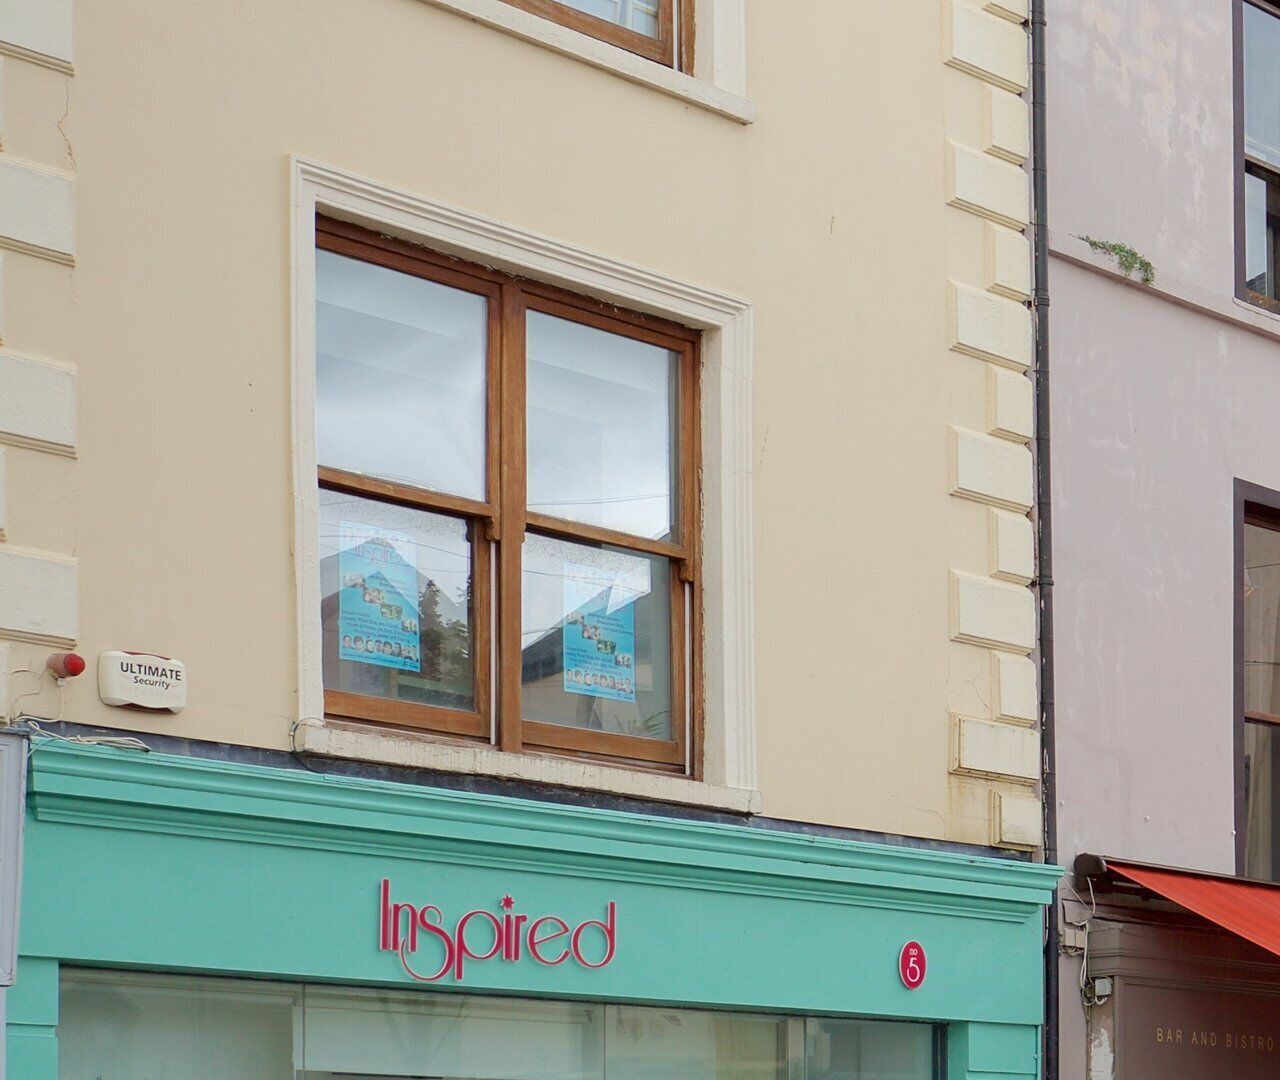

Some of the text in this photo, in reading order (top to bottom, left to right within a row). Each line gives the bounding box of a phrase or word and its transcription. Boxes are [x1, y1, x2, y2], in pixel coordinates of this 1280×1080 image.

[121, 662, 182, 681] ULTIMATE
[134, 676, 170, 690] Security
[380, 878, 617, 982] Inspired
[907, 957, 920, 982] 5
[1156, 1028, 1274, 1051] BAR AND BISTRO
